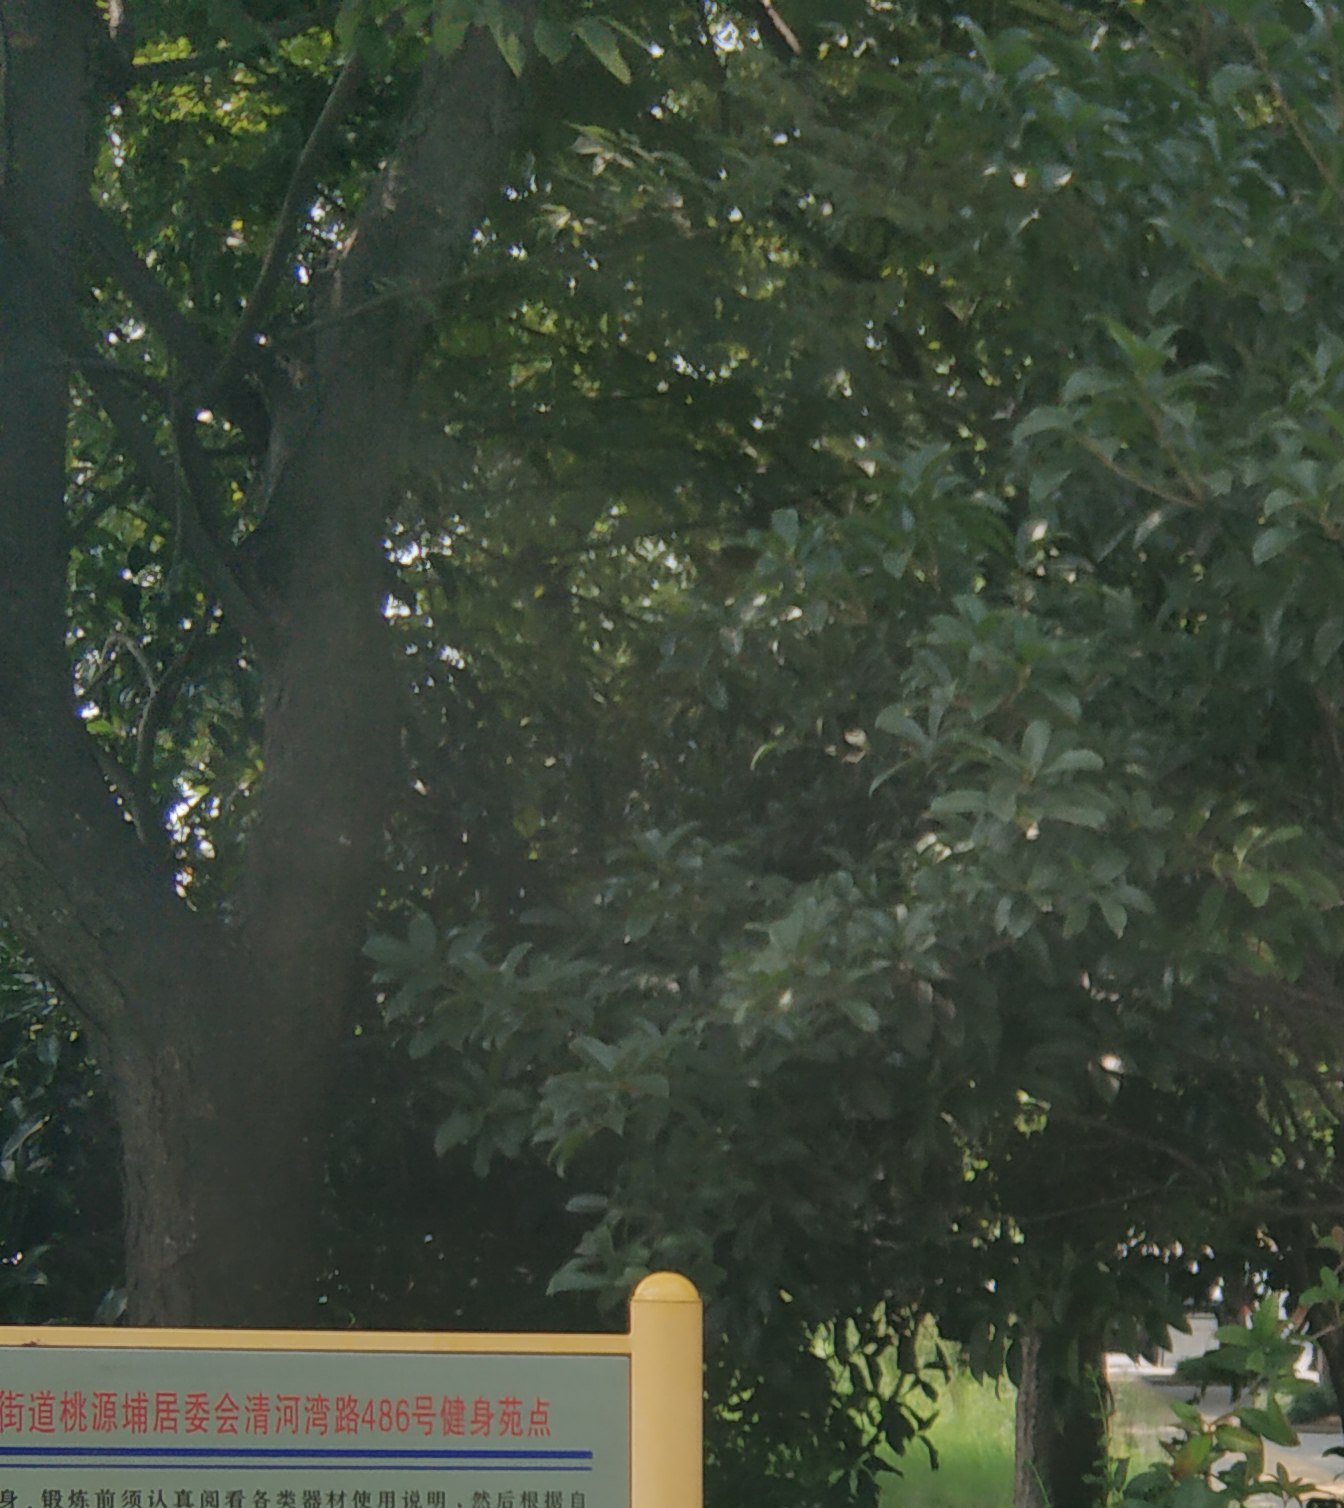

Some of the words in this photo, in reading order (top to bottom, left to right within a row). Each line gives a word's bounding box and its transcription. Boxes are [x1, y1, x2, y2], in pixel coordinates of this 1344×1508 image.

[0, 1389, 552, 1439] 街道桃源埔居委会清河湾路486号健身苑点
